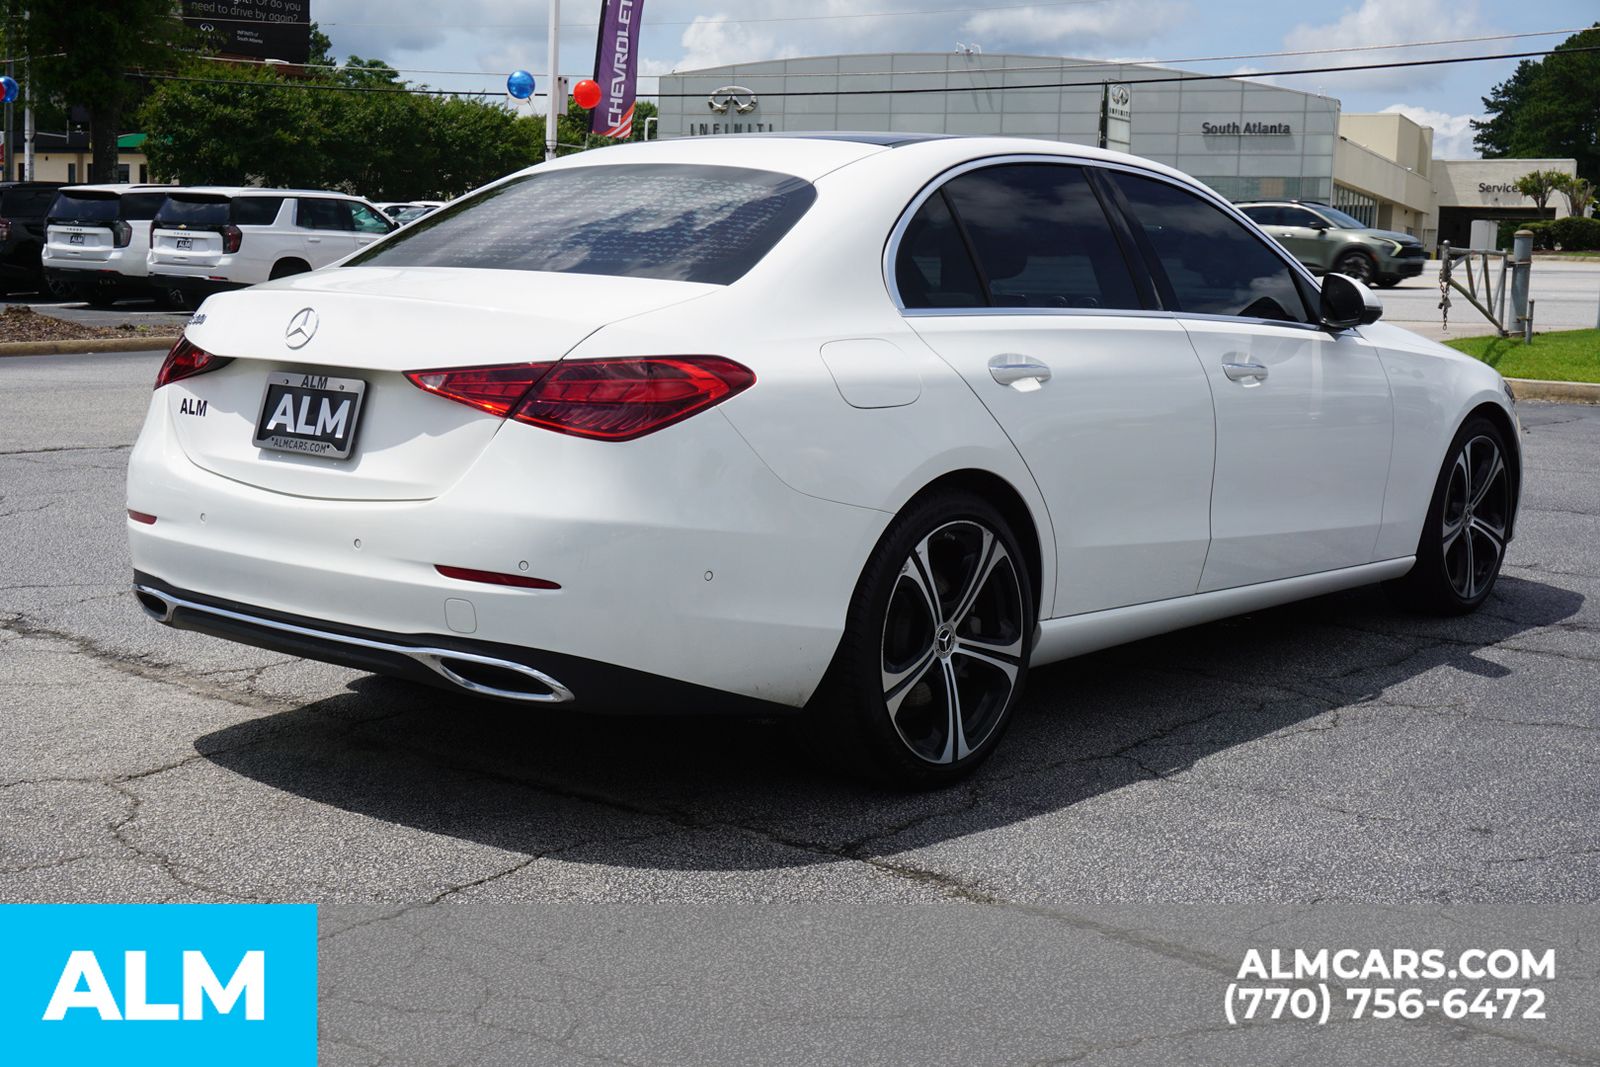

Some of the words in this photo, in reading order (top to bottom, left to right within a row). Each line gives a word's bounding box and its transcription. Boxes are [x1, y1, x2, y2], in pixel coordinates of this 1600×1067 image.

[191, 2, 215, 12] need
[217, 5, 228, 14] to
[230, 6, 253, 17] drive
[255, 9, 267, 21] by
[269, 13, 298, 24] again?
[270, 0, 283, 8] do
[284, 2, 301, 12] you
[607, 0, 633, 127] CHEVROLET
[690, 123, 774, 136] INFINITI
[1201, 122, 1240, 134] South
[1243, 122, 1291, 134] Atlanta
[301, 375, 328, 389] ALM
[180, 398, 208, 416] ALM
[266, 393, 351, 439] ALM
[272, 439, 327, 453] ALMCARS.COM
